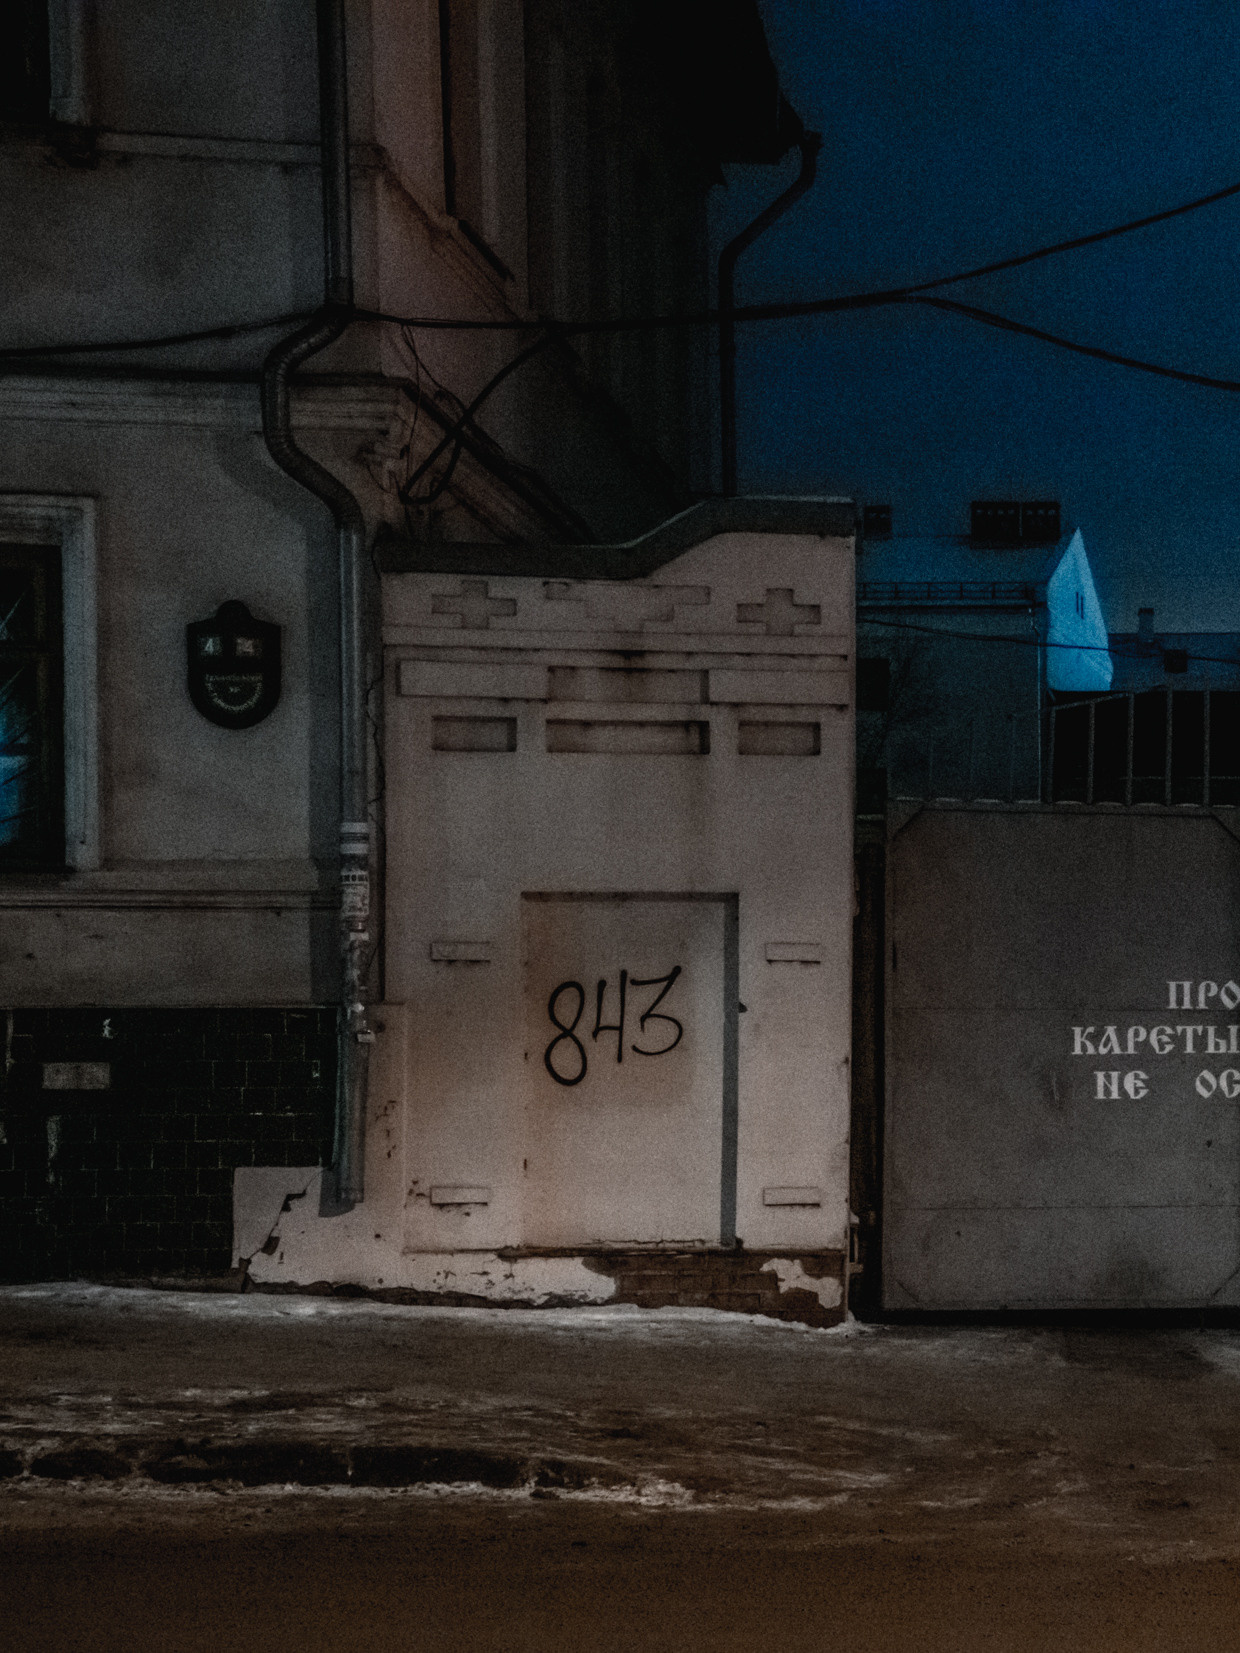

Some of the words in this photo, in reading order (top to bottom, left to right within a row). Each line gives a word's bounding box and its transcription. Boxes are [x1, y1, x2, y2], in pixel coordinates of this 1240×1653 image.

[545, 965, 683, 1087] 843
[1071, 1025, 1240, 1055] КАРЕТЫ
[1094, 1070, 1149, 1100] НЕ
